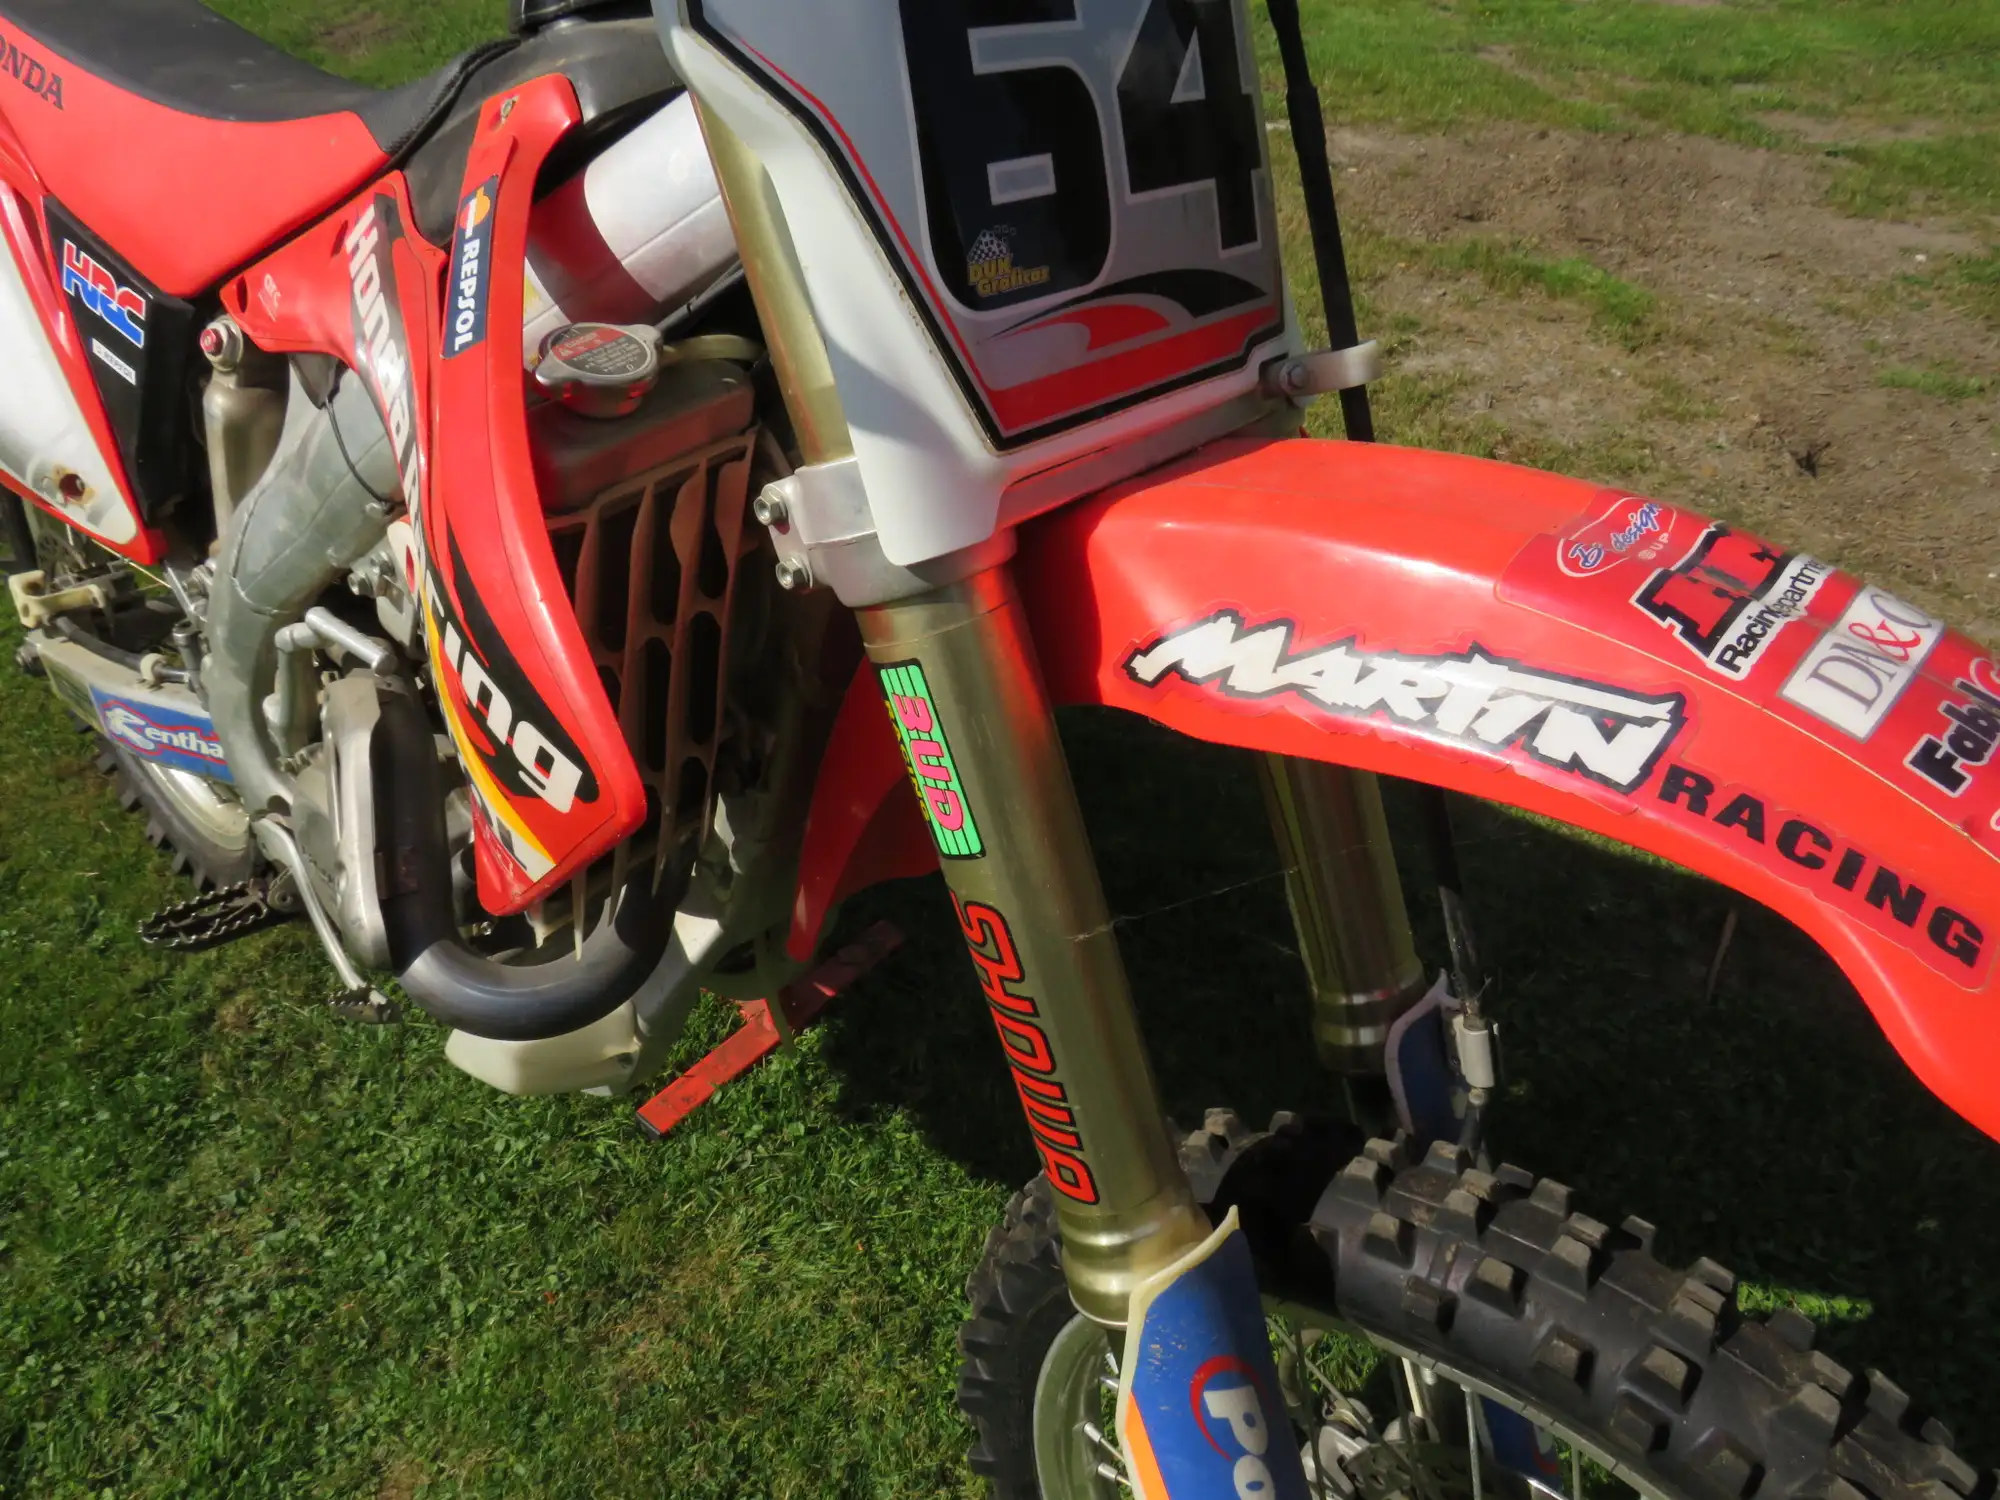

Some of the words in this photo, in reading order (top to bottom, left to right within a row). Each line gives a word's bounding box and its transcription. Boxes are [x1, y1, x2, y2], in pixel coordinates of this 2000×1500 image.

[899, 0, 1263, 311] 64
[62, 238, 147, 349] HRC
[453, 238, 481, 351] REPSOL
[104, 707, 224, 759] Rentha
[892, 692, 964, 833] BUD
[1127, 611, 1684, 790] MARTIN
[1657, 763, 1984, 969] RACING
[949, 889, 1099, 1206] SHOWA
